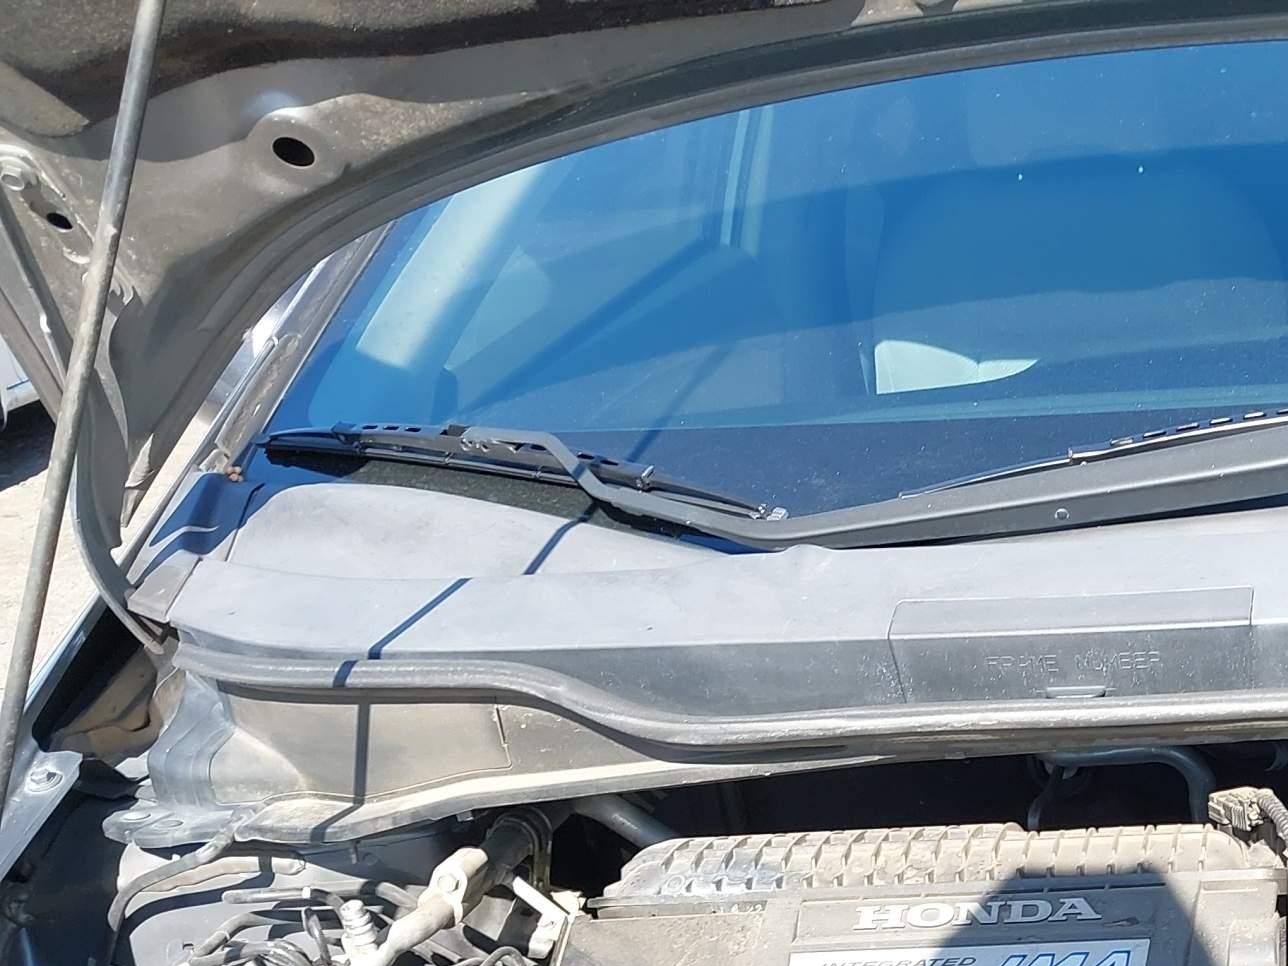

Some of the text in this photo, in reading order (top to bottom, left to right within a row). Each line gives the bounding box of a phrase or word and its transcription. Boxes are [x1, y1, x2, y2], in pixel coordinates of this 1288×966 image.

[984, 648, 1161, 672] FRAME NUMBER
[852, 897, 1102, 930] HONDA
